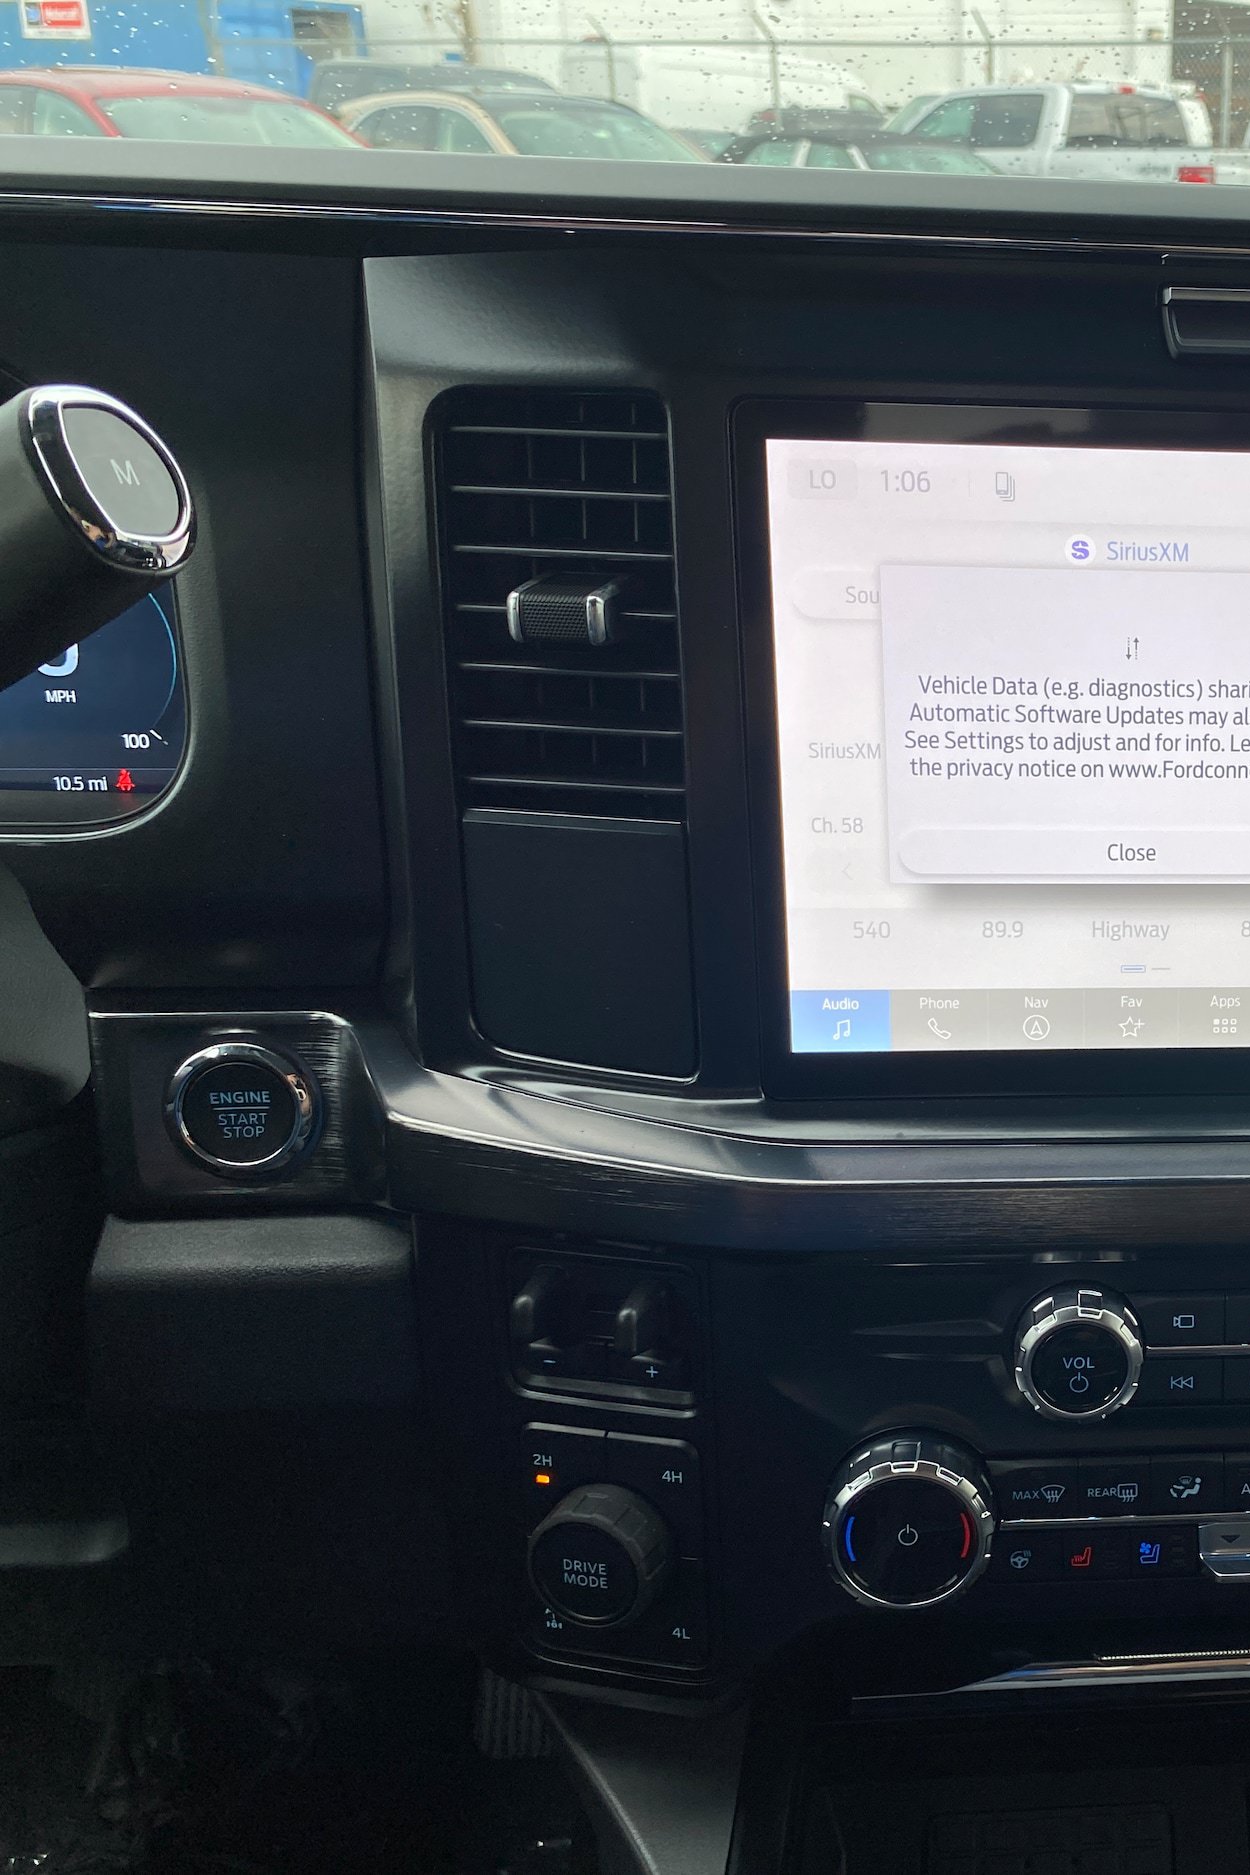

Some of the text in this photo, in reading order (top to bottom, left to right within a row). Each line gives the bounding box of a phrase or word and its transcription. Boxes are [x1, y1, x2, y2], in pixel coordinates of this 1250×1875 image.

[111, 459, 140, 486] M
[809, 471, 836, 490] LO
[880, 470, 930, 493] 1:06
[1107, 542, 1189, 562] SiriusXM
[845, 586, 879, 604] Sou
[45, 690, 77, 703] MPH
[919, 676, 988, 695] Vehicle
[992, 677, 1038, 696] Data
[1043, 677, 1084, 699] (e.g.
[1088, 678, 1203, 701] diagnostics)
[910, 703, 1009, 723] Automatic
[1015, 704, 1102, 724] Software
[1106, 705, 1184, 728] Updates
[1189, 709, 1227, 728] may
[121, 733, 150, 749] 100
[905, 731, 939, 750] See
[945, 732, 1024, 753] Settings
[1029, 734, 1048, 751] to
[1054, 732, 1110, 755] adjust
[1115, 733, 1150, 752] and
[1155, 733, 1181, 752] for
[1186, 733, 1225, 753] info.
[808, 742, 881, 760] SiriusXM
[911, 759, 942, 777] the
[947, 761, 1012, 780] privacy
[1018, 761, 1076, 778] notice
[1081, 764, 1104, 778] on
[53, 776, 108, 791] 10.5 mi
[812, 818, 863, 834] Ch. 58
[1107, 844, 1156, 862] Close
[853, 921, 890, 939] 540
[982, 921, 1023, 939] 89.9
[1092, 921, 1170, 942] Highway
[822, 997, 859, 1010] Audio
[919, 997, 959, 1010] Phone
[1025, 996, 1048, 1009] Nav
[1121, 996, 1142, 1008] Fav
[1211, 995, 1240, 1009] Apps
[210, 1091, 270, 1104] ENGINE
[218, 1113, 267, 1125] START
[224, 1126, 265, 1139] STOP
[1063, 1357, 1095, 1369] VOL
[533, 1454, 552, 1467] 2H
[661, 1470, 683, 1484] 4H
[1013, 1489, 1040, 1500] MAX
[1088, 1487, 1117, 1498] REAR
[563, 1558, 607, 1576] DRIVE
[564, 1572, 608, 1589] MODE
[672, 1627, 690, 1640] 4L
